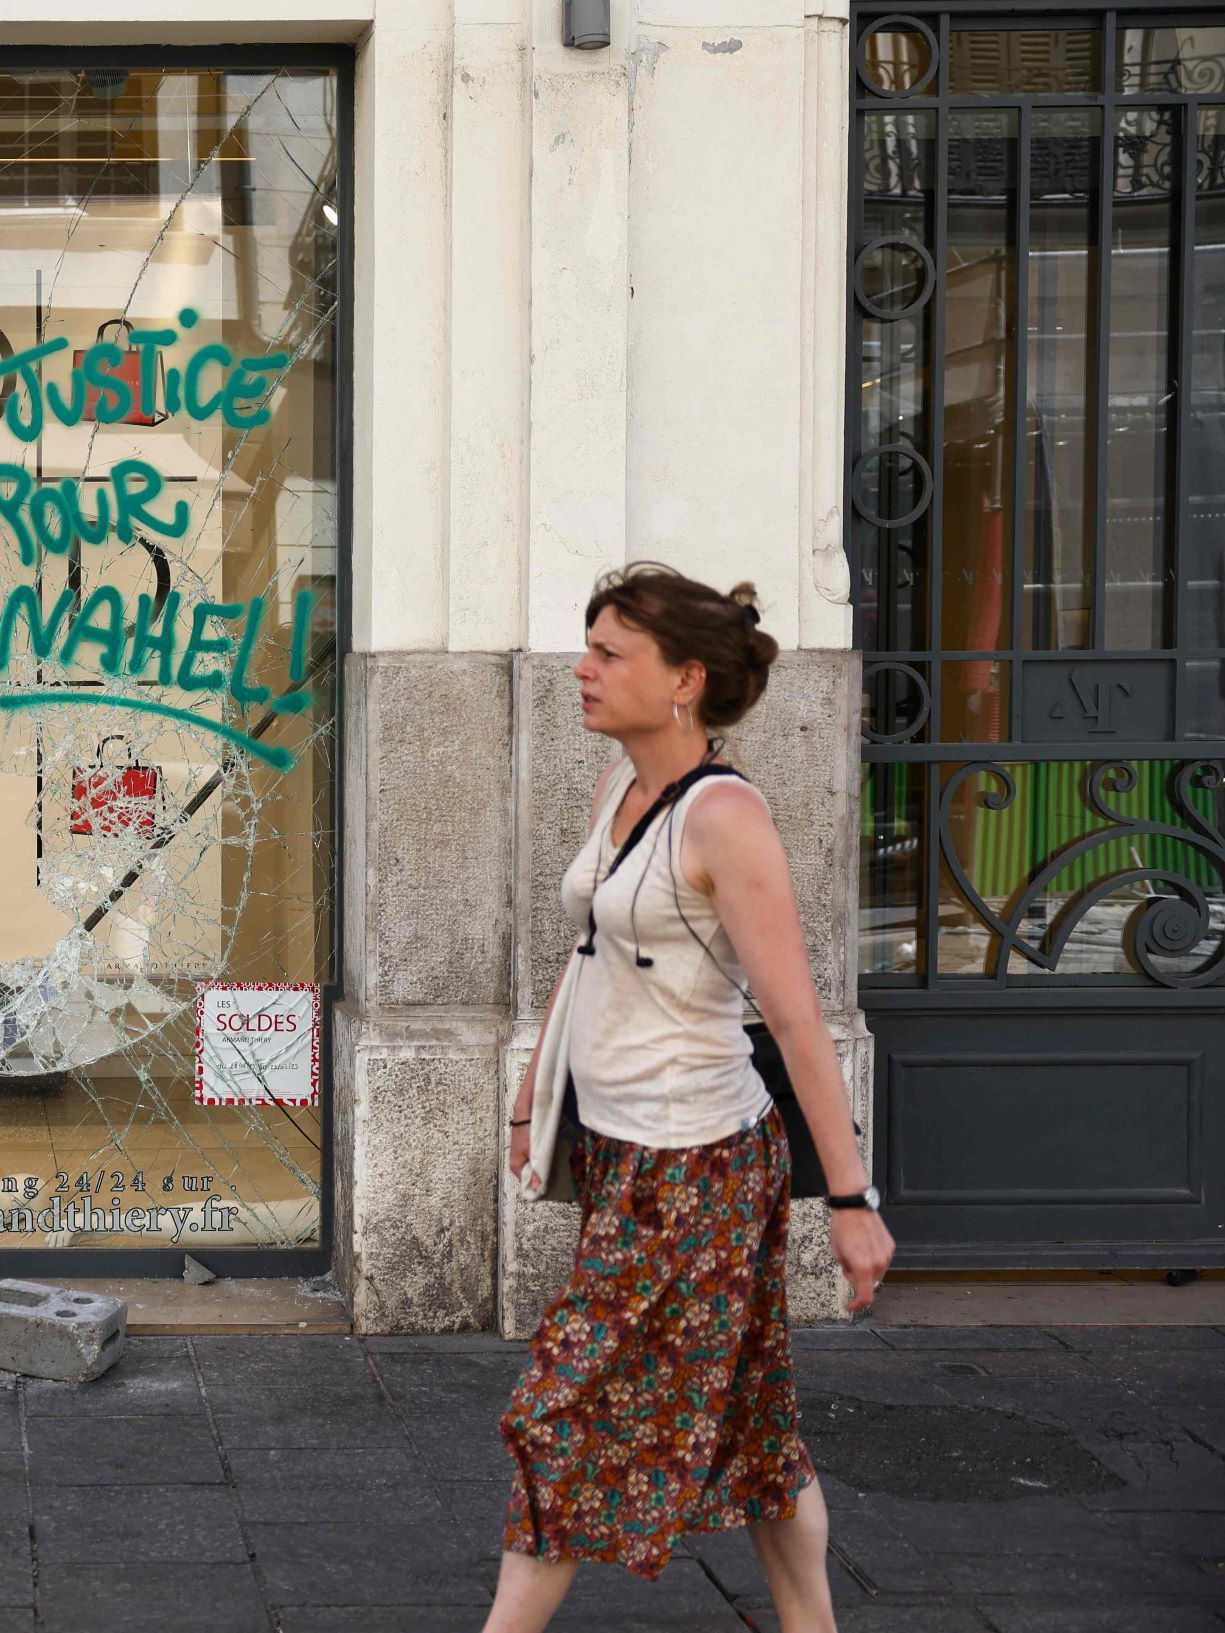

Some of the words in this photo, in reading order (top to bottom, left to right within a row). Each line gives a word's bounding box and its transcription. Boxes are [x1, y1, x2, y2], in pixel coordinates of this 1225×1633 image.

[217, 1000, 231, 1008] LES
[216, 1013, 297, 1032] SOLDES
[55, 1171, 147, 1193] 24/24
[162, 1175, 214, 1192] sur
